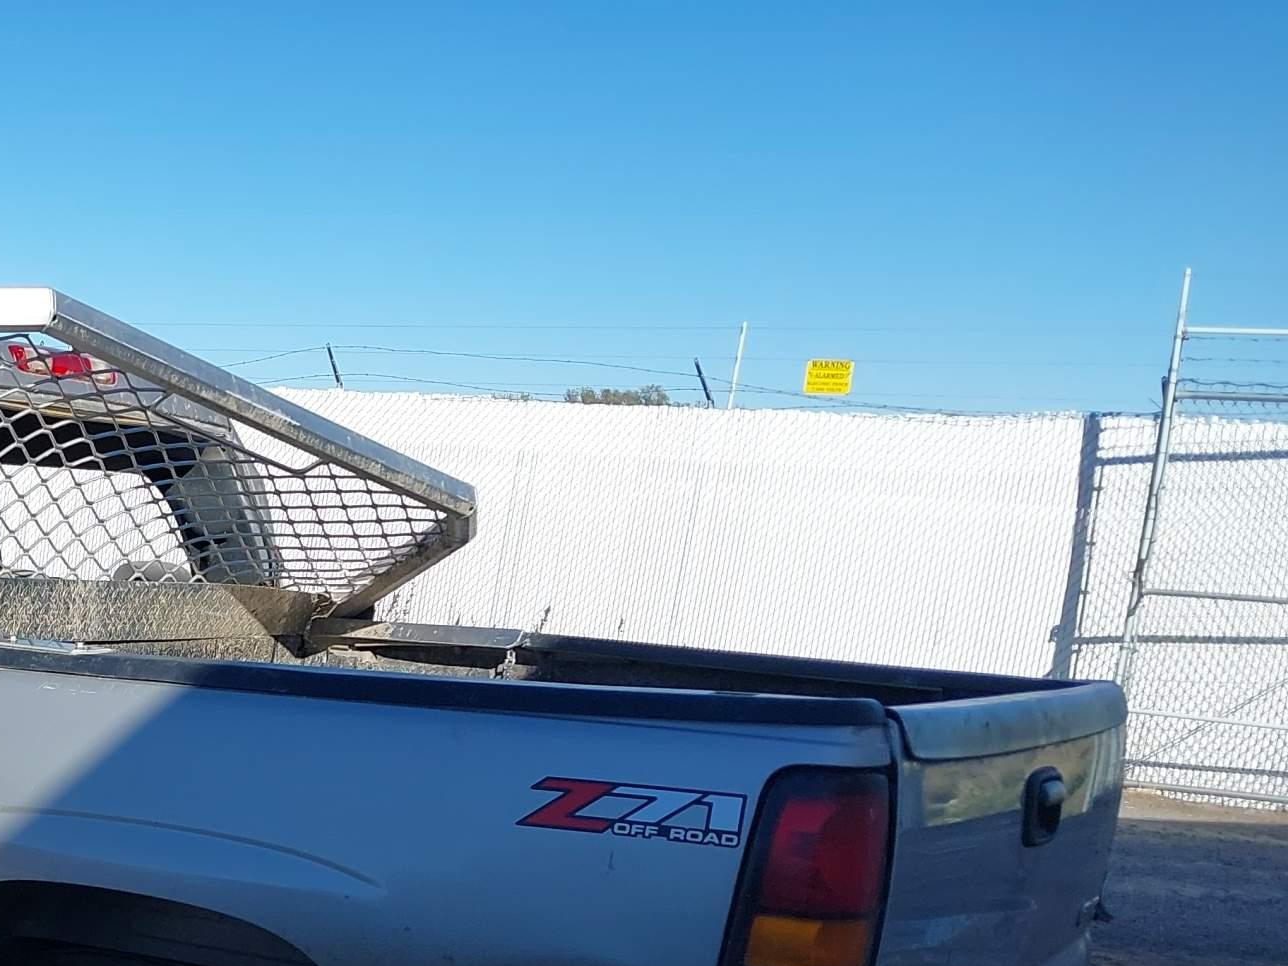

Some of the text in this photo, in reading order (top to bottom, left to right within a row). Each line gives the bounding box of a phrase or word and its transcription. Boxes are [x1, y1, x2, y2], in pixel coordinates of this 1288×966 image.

[812, 360, 851, 369] WARNING
[515, 776, 748, 833] Z71
[612, 822, 739, 847] OFF ROAD
